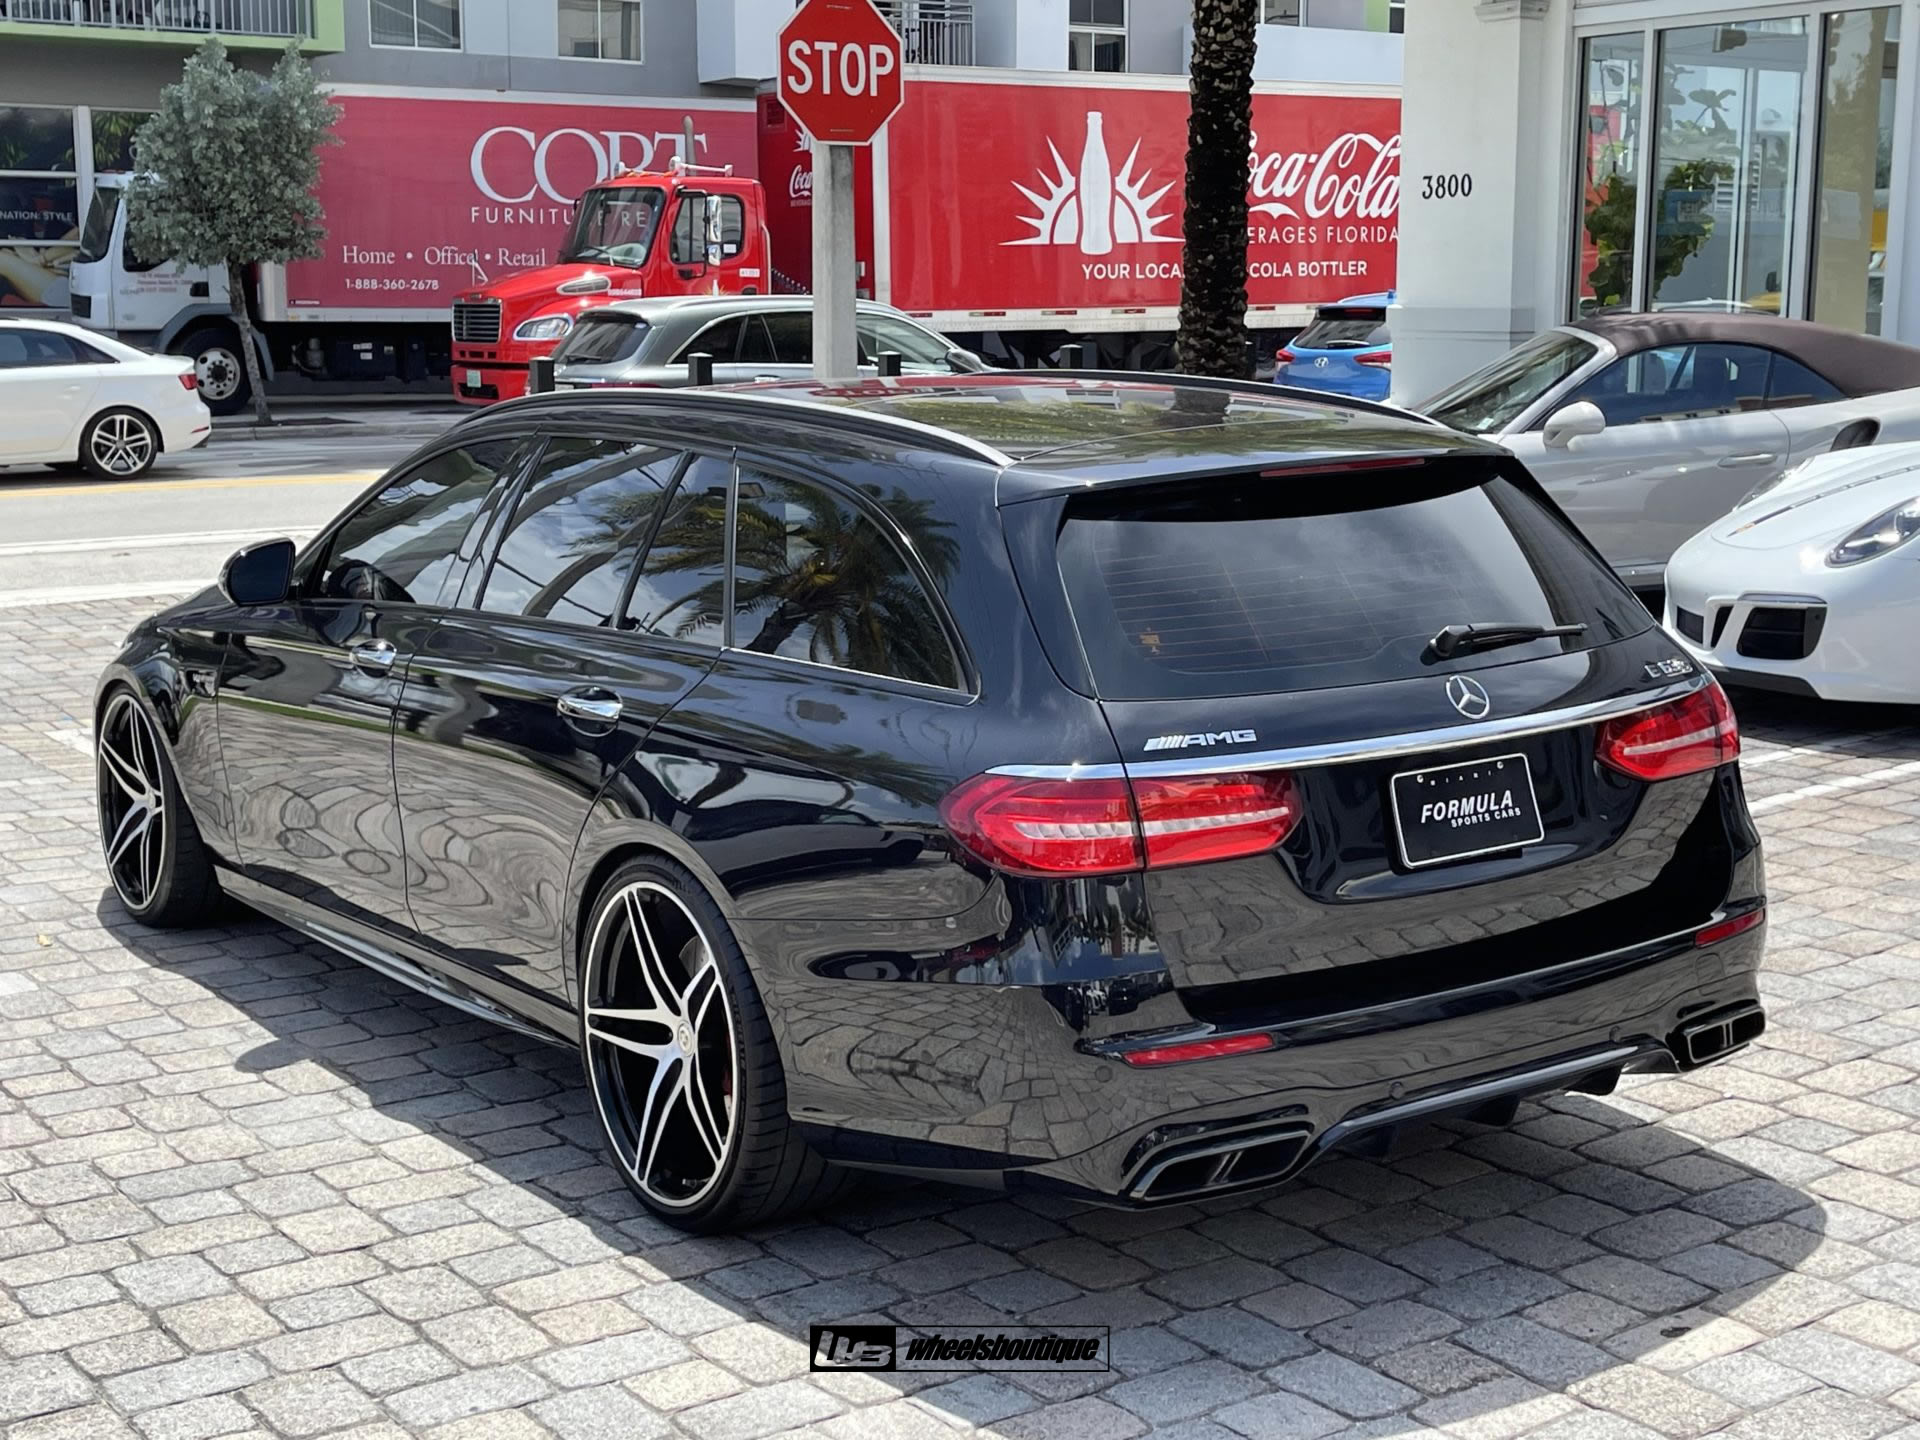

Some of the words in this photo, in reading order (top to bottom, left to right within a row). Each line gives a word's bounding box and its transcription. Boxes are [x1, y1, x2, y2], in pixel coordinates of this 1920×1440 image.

[787, 40, 894, 96] STOP
[471, 126, 707, 205] CORT
[1422, 173, 1472, 199] 3800
[42, 211, 73, 221] STYLE
[1247, 226, 1317, 244] ERAGES
[1327, 226, 1399, 243] FLORIDA
[342, 245, 395, 264] Home
[424, 246, 477, 265] Office
[497, 248, 546, 267] Retail
[1082, 264, 1130, 280] YOUR
[1135, 263, 1186, 279] LOCA
[1298, 261, 1368, 276] BOTTLER
[345, 278, 439, 290] 1-888-360-2678
[1421, 790, 1513, 823] FORMULA
[1451, 813, 1490, 828] SPORTS
[1494, 807, 1522, 820] CARS
